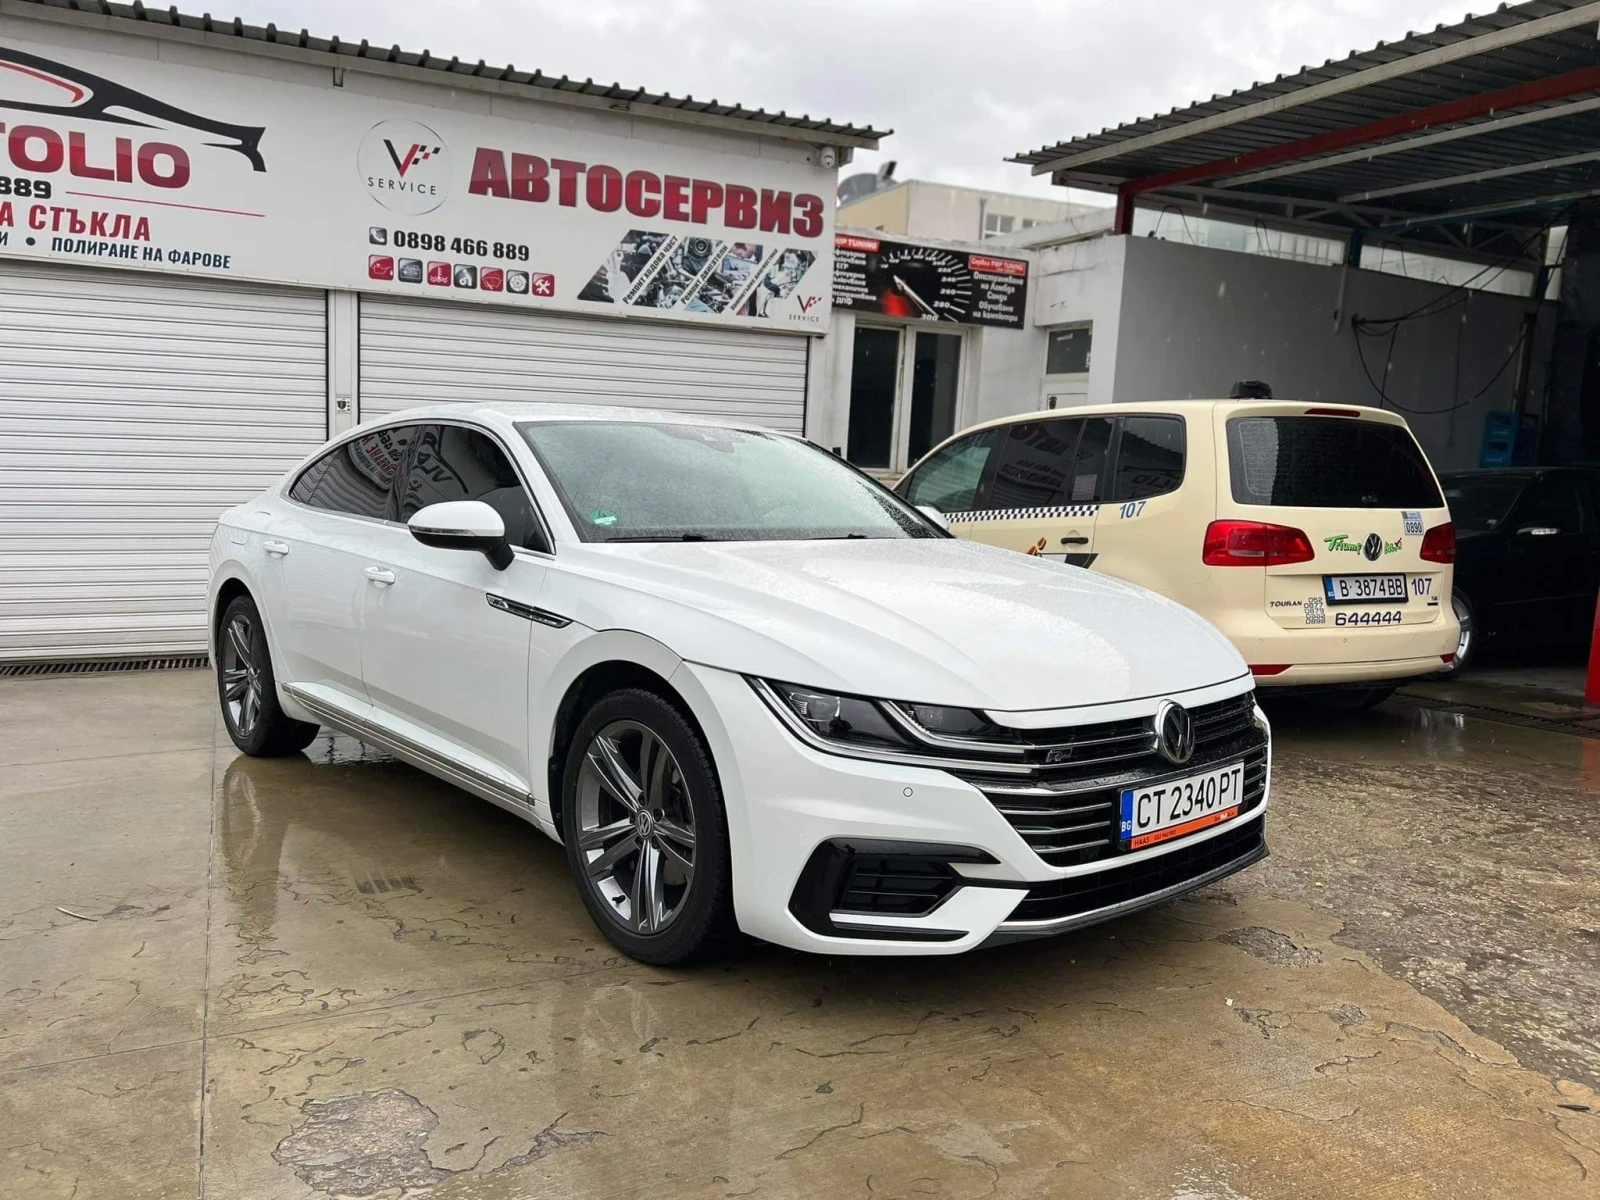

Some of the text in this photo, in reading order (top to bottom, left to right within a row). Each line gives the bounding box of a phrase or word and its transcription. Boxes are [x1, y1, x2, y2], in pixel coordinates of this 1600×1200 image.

[368, 176, 436, 195] SERVICE
[468, 147, 824, 238] АВТОСЕРВИЗ
[28, 204, 151, 241] СТЪКЛА
[52, 237, 138, 260] ПОЛИРАНЕ
[143, 247, 163, 262] НА
[168, 249, 231, 269] ФАРОВЕ
[393, 230, 529, 262] 0898 466 889
[788, 314, 819, 323] SERVICE
[921, 313, 938, 321] 300
[1120, 501, 1147, 519] 107
[1406, 521, 1422, 533] 0890
[1355, 579, 1386, 597] 3874
[1411, 578, 1432, 595] 107
[1335, 611, 1402, 626] 644444
[1121, 769, 1241, 832] BG CT 2340 PT
[1134, 836, 1150, 847] HAAS
